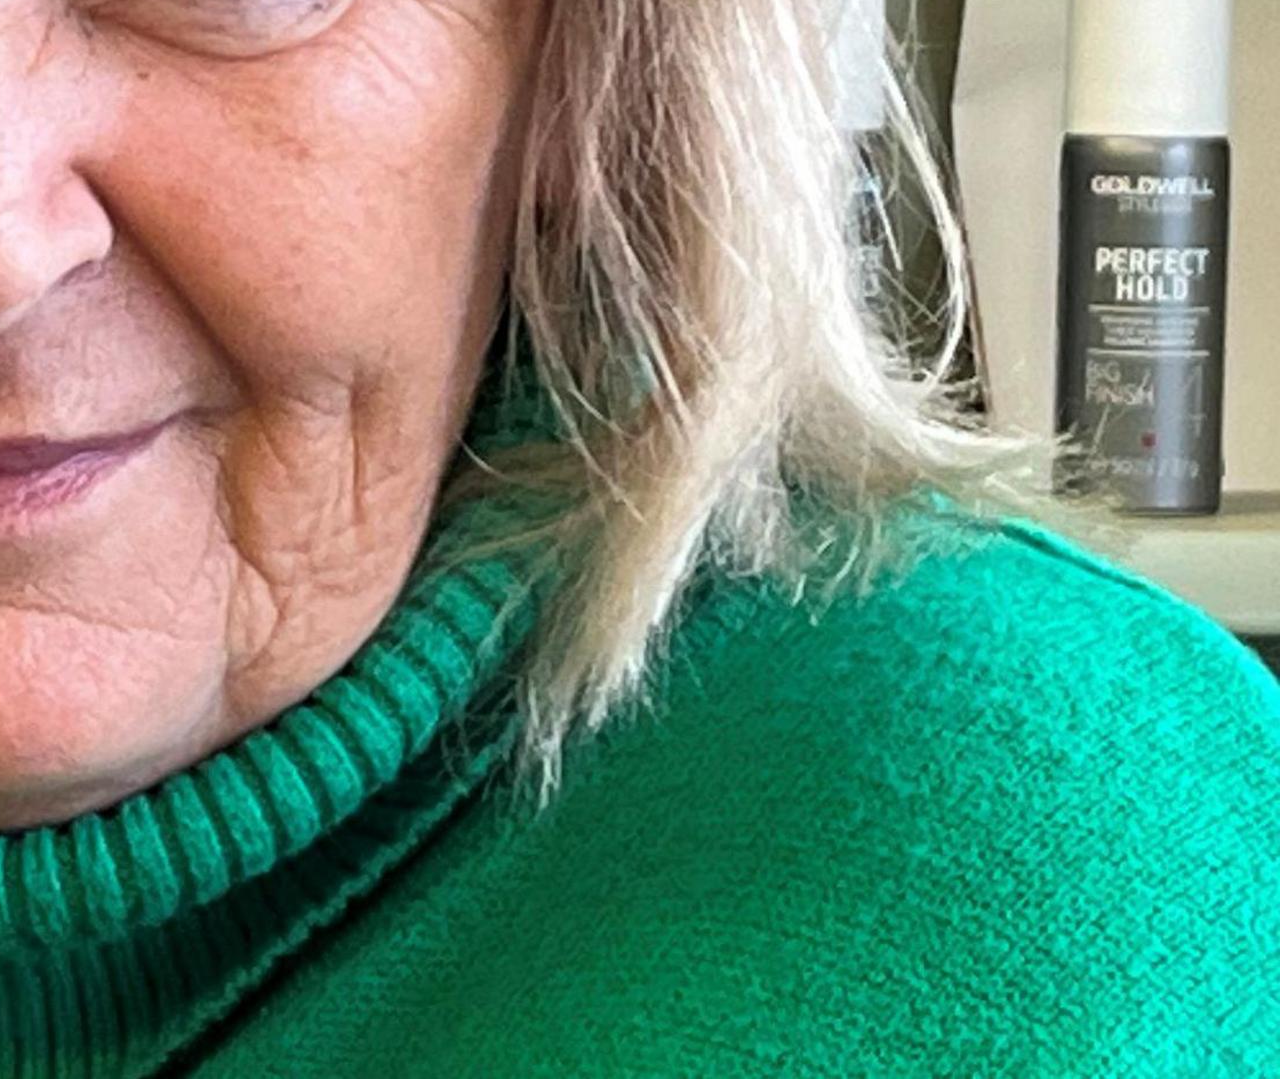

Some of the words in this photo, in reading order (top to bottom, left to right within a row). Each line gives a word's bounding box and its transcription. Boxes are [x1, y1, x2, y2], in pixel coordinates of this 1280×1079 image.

[1090, 175, 1215, 197] GOLDWELL
[1095, 246, 1210, 277] PERFECT
[1116, 274, 1188, 301] HOLD
